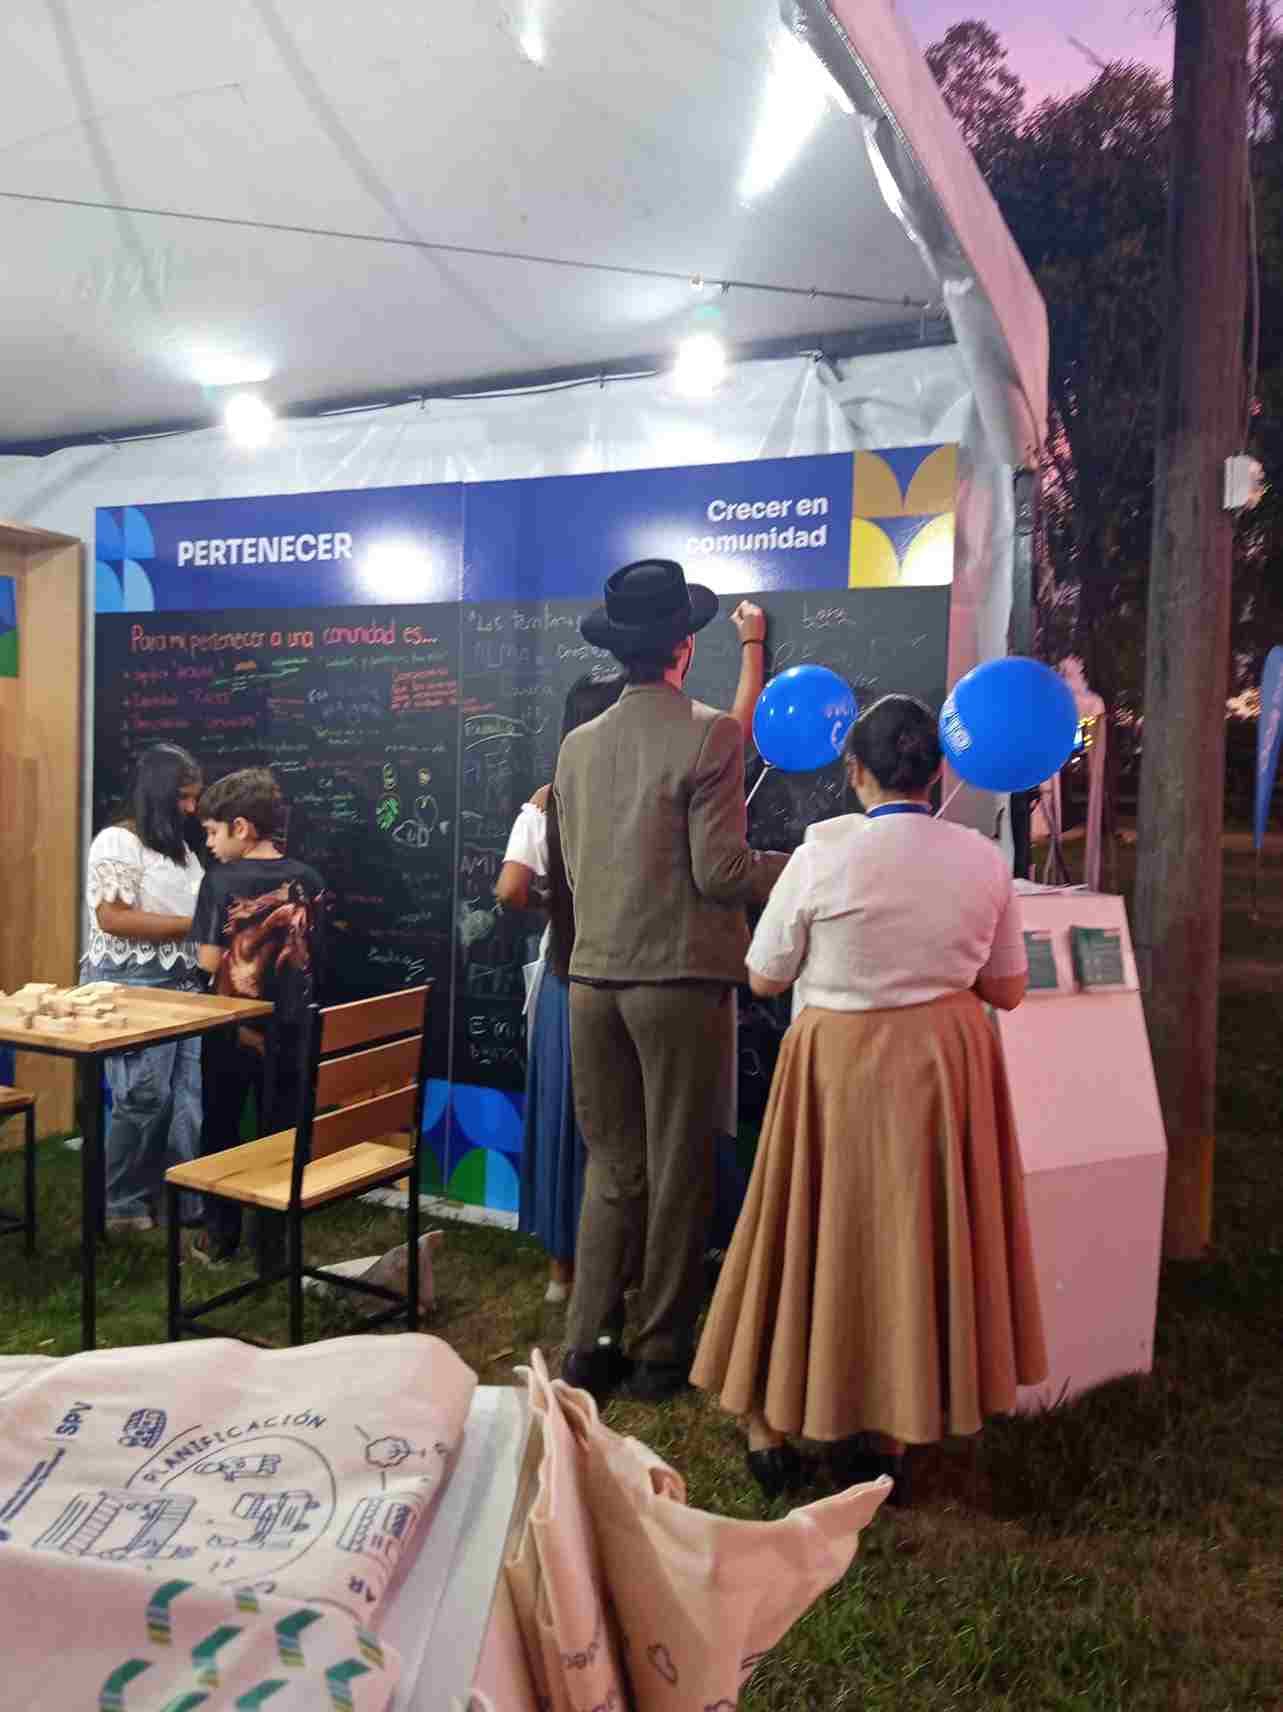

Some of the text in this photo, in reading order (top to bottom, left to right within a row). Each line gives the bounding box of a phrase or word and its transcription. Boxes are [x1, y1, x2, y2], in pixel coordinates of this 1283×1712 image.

[707, 496, 829, 522] Crecer en
[177, 531, 353, 567] PERTENECER
[686, 525, 828, 553] comunidad
[270, 631, 282, 648] a
[55, 1401, 93, 1436] SPV
[143, 1407, 327, 1481] PLANIFICACIÓN
